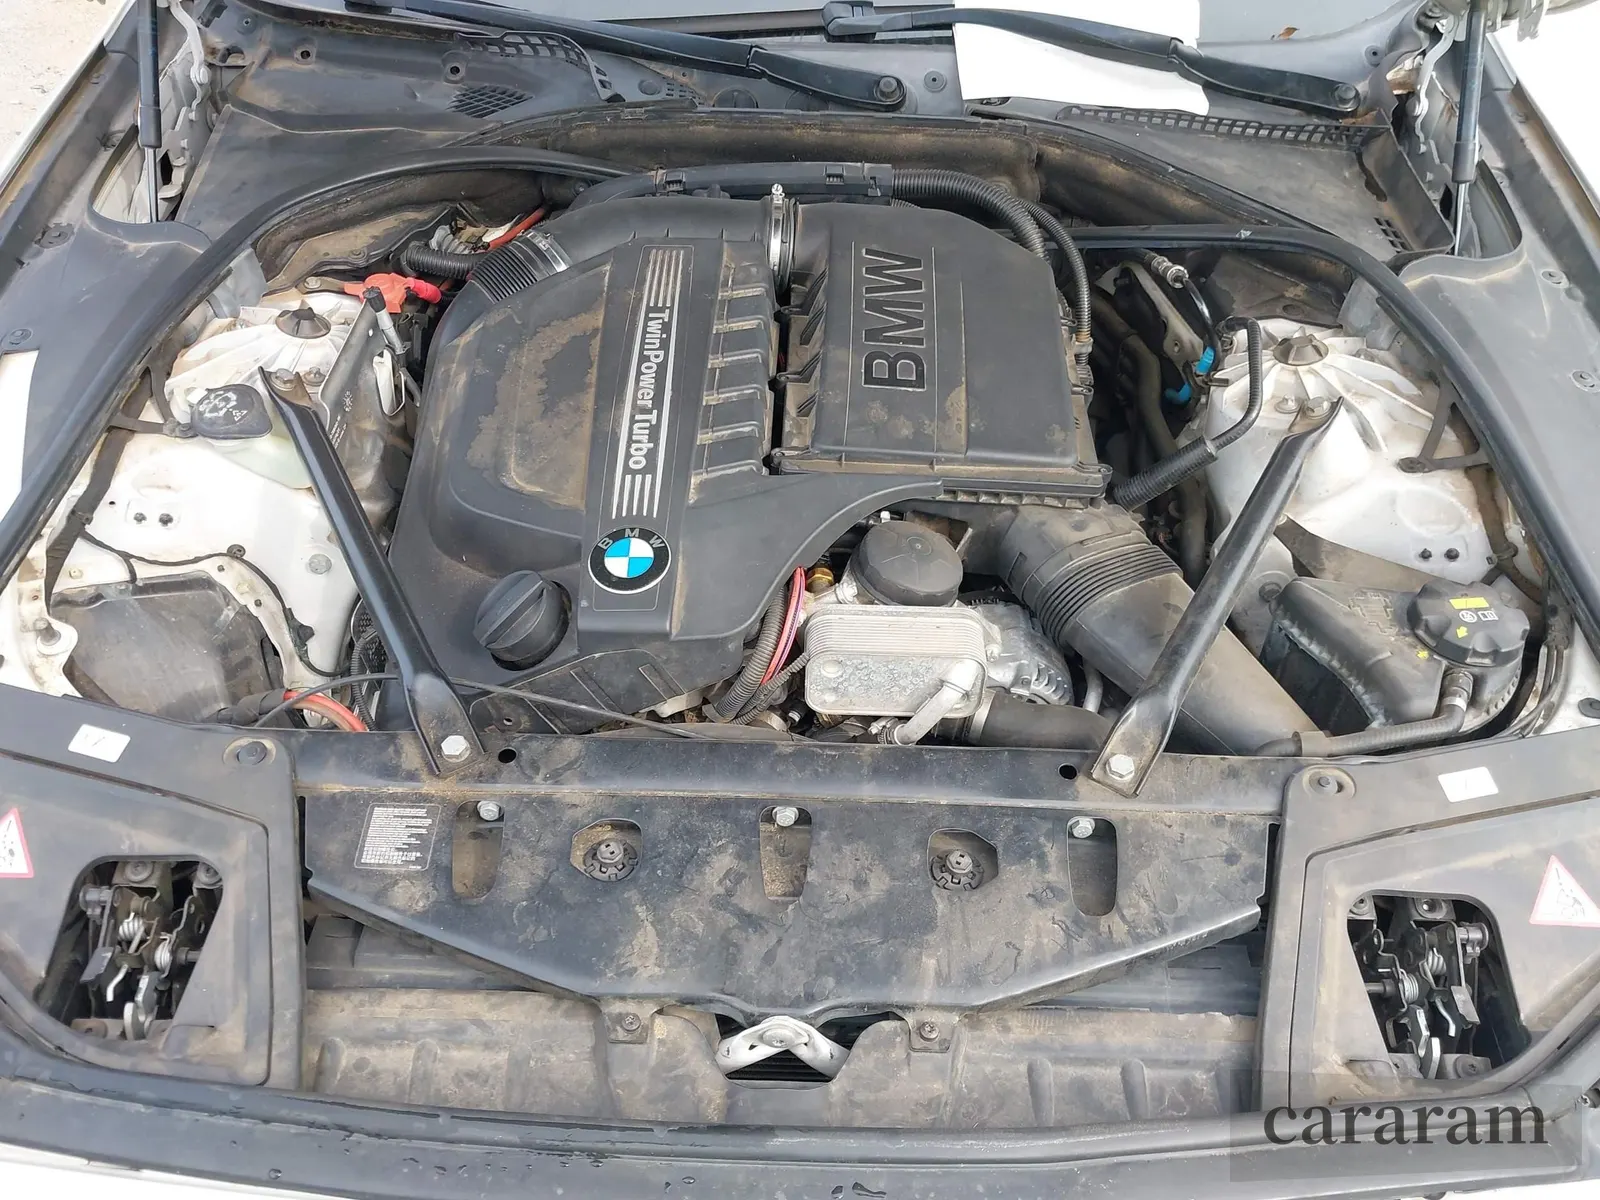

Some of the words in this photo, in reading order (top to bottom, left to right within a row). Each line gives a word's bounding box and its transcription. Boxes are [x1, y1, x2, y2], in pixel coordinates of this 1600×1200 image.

[637, 308, 670, 409] TwinPower
[861, 247, 926, 391] BMW
[628, 409, 658, 470] Turbo
[597, 528, 665, 550] BMW
